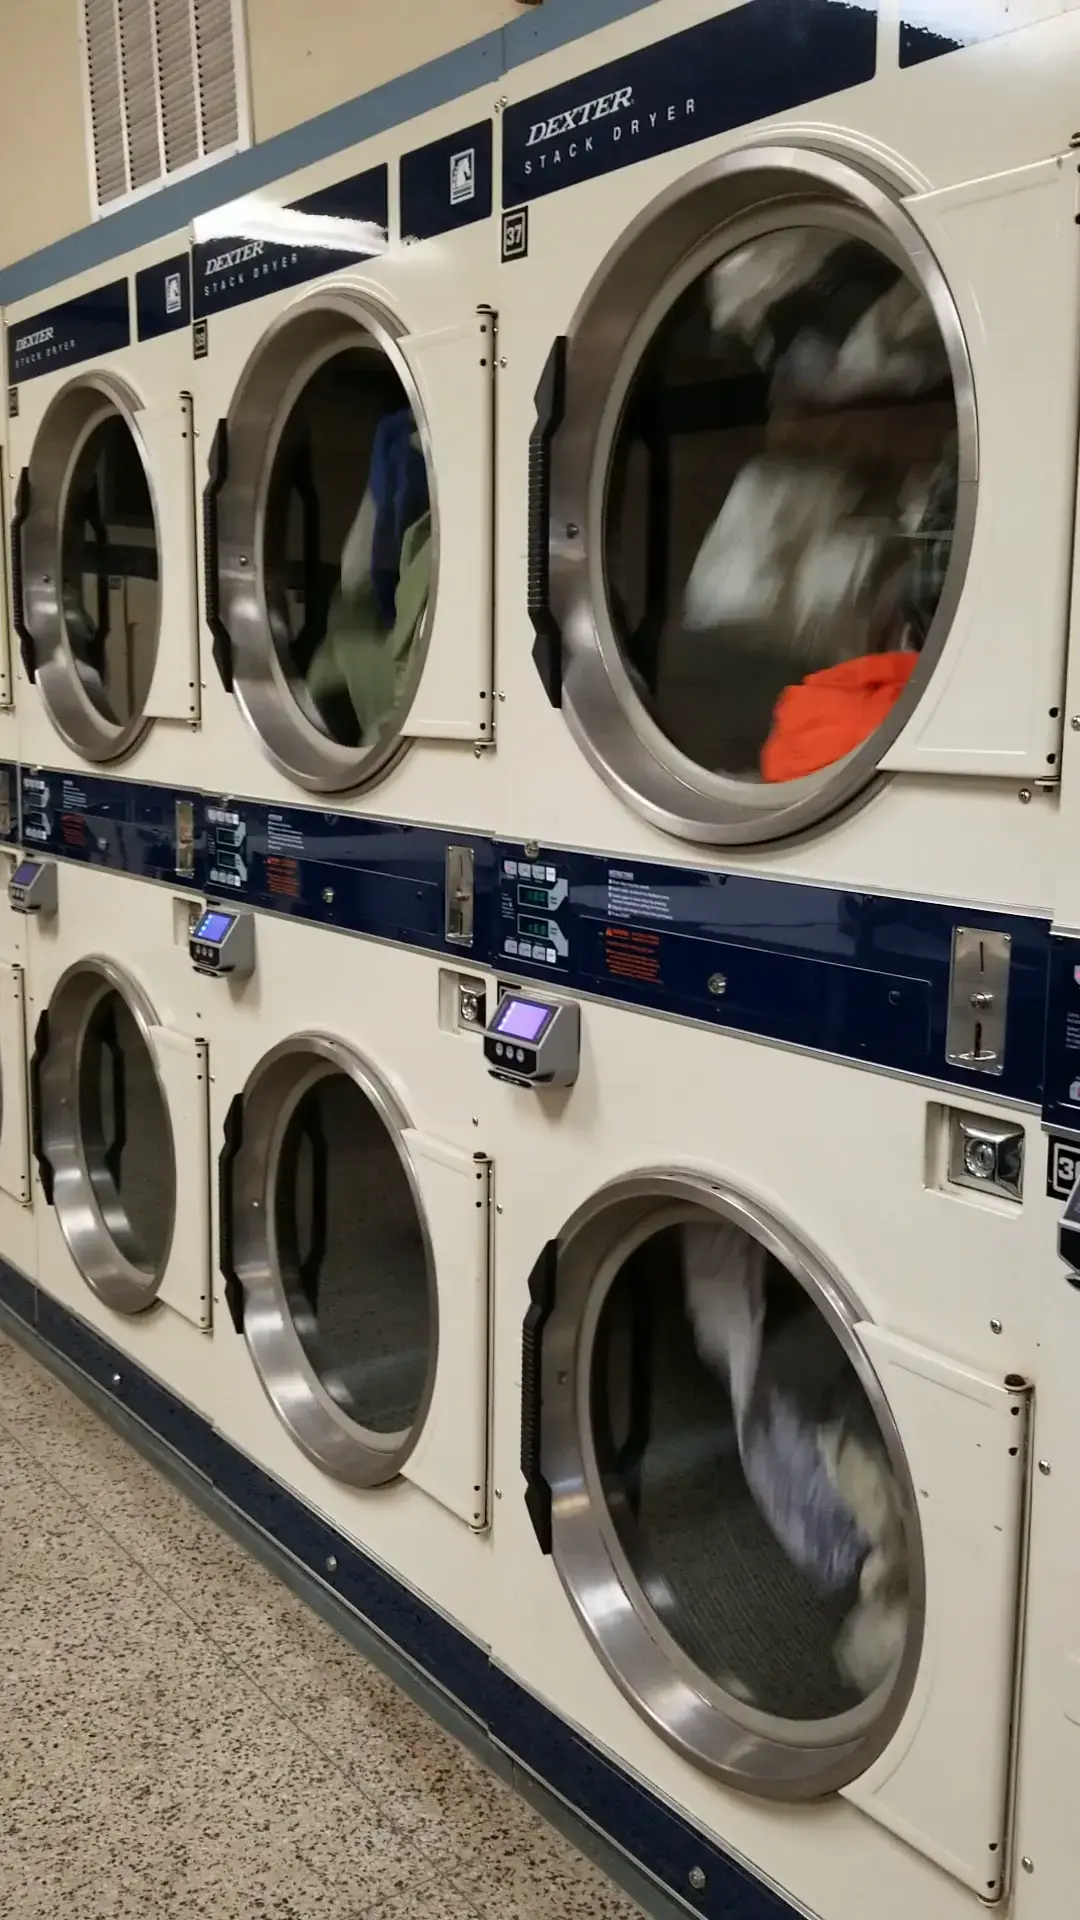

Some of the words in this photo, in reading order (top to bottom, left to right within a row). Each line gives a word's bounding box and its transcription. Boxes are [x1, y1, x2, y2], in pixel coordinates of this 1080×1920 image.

[524, 137, 594, 175] STACK
[613, 98, 695, 141] DRYER
[525, 86, 633, 147] DEXTER
[506, 223, 523, 246] 37
[204, 240, 265, 276] DEXTER
[204, 273, 244, 297] STACK
[252, 252, 298, 279] DRYER
[15, 326, 54, 352] DEXTER
